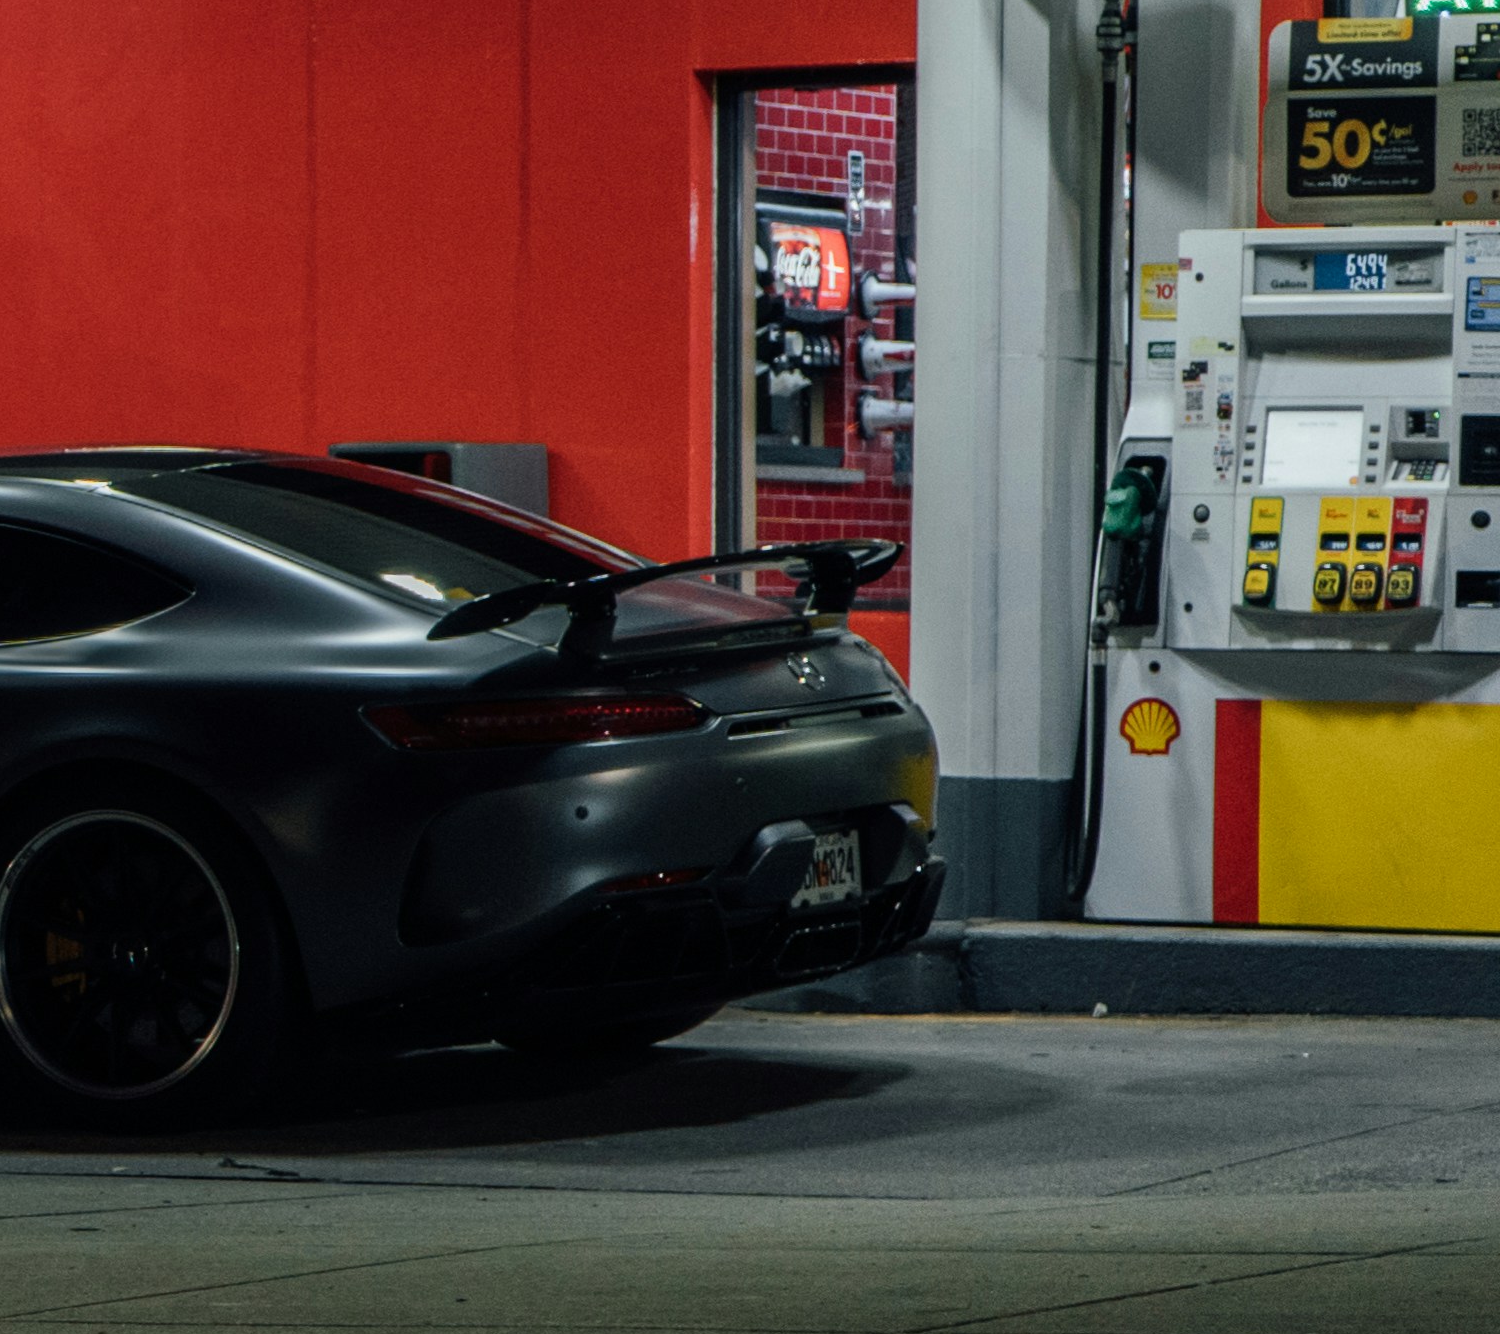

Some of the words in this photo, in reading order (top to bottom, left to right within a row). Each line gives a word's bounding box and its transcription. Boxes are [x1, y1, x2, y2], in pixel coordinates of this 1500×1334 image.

[1302, 53, 1345, 83] 5X
[1350, 57, 1423, 80] Savings
[1306, 107, 1338, 119] Save
[1270, 279, 1308, 289] Gallons
[1354, 578, 1373, 590] 89
